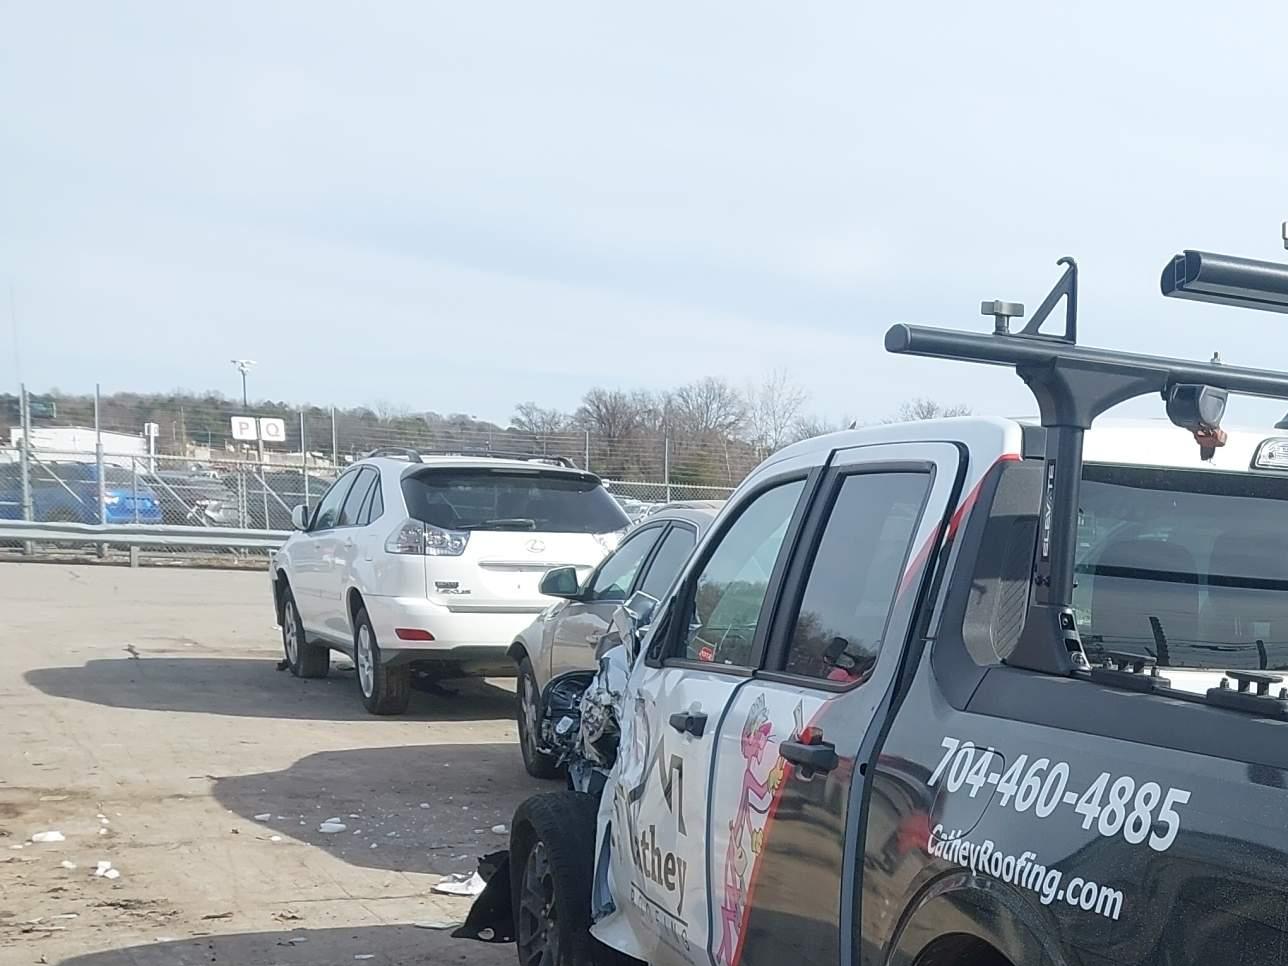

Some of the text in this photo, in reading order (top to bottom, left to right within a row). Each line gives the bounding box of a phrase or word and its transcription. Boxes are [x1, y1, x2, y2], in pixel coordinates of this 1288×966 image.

[238, 421, 249, 435] P
[265, 422, 281, 437] Q
[1042, 463, 1056, 557] ELEVATE
[927, 736, 1192, 852] 704-460-4885
[927, 824, 1124, 920] CatheyRoofing.com
